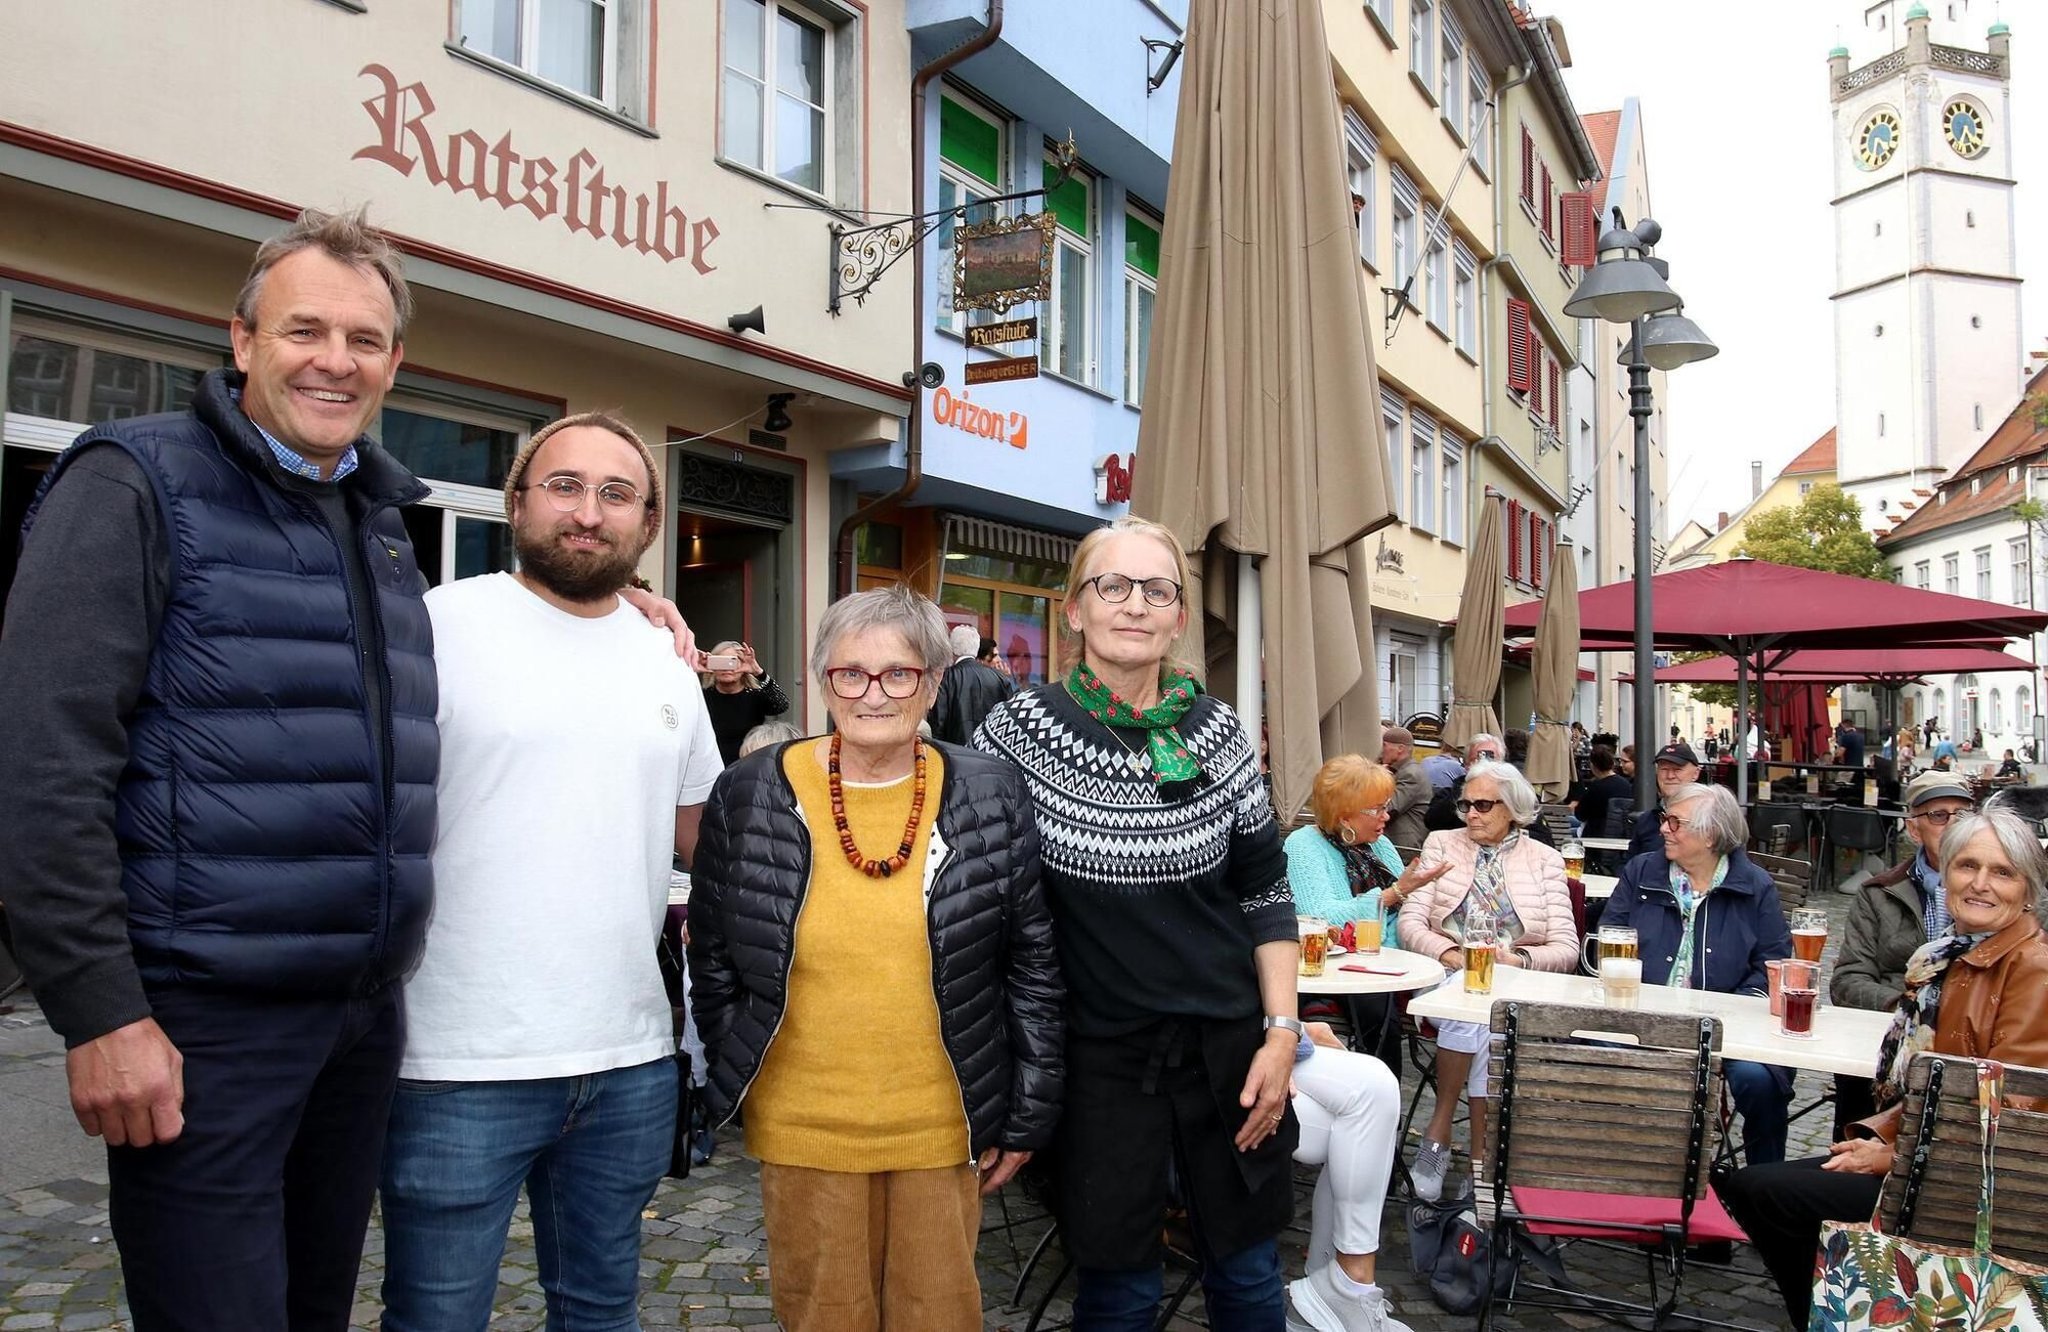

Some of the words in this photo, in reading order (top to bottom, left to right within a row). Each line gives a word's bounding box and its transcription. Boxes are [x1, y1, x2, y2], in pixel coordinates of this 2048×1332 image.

[351, 63, 721, 275] Ratsstube
[971, 322, 1030, 345] Ratsstube
[933, 387, 1004, 442] Orizon
